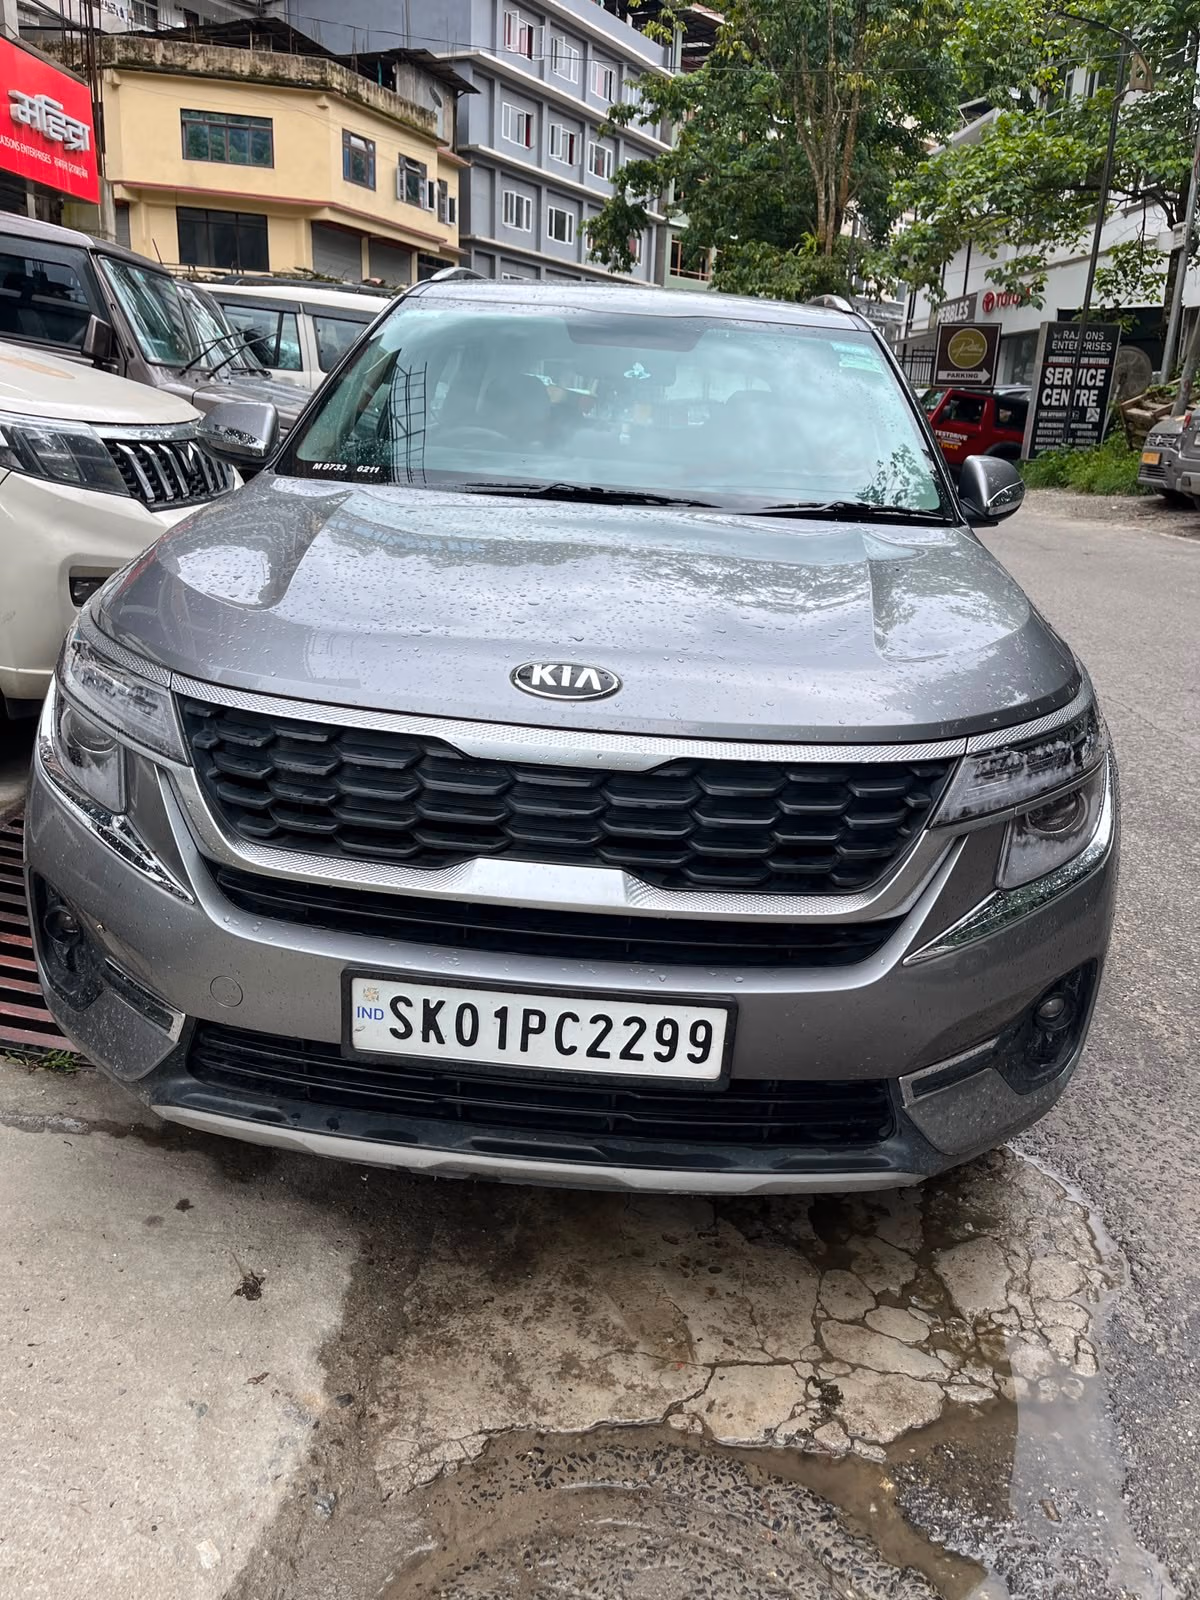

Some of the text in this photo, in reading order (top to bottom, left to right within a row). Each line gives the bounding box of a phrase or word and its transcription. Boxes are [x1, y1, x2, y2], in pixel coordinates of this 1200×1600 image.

[20, 142, 52, 165] ENTERPRISES
[936, 300, 970, 325] PEBBLES
[1062, 330, 1105, 341] RAJONS
[356, 465, 380, 473] 6211
[530, 664, 602, 691] KIA
[357, 1006, 384, 1020] IND
[388, 995, 714, 1064] SK01PC2299
